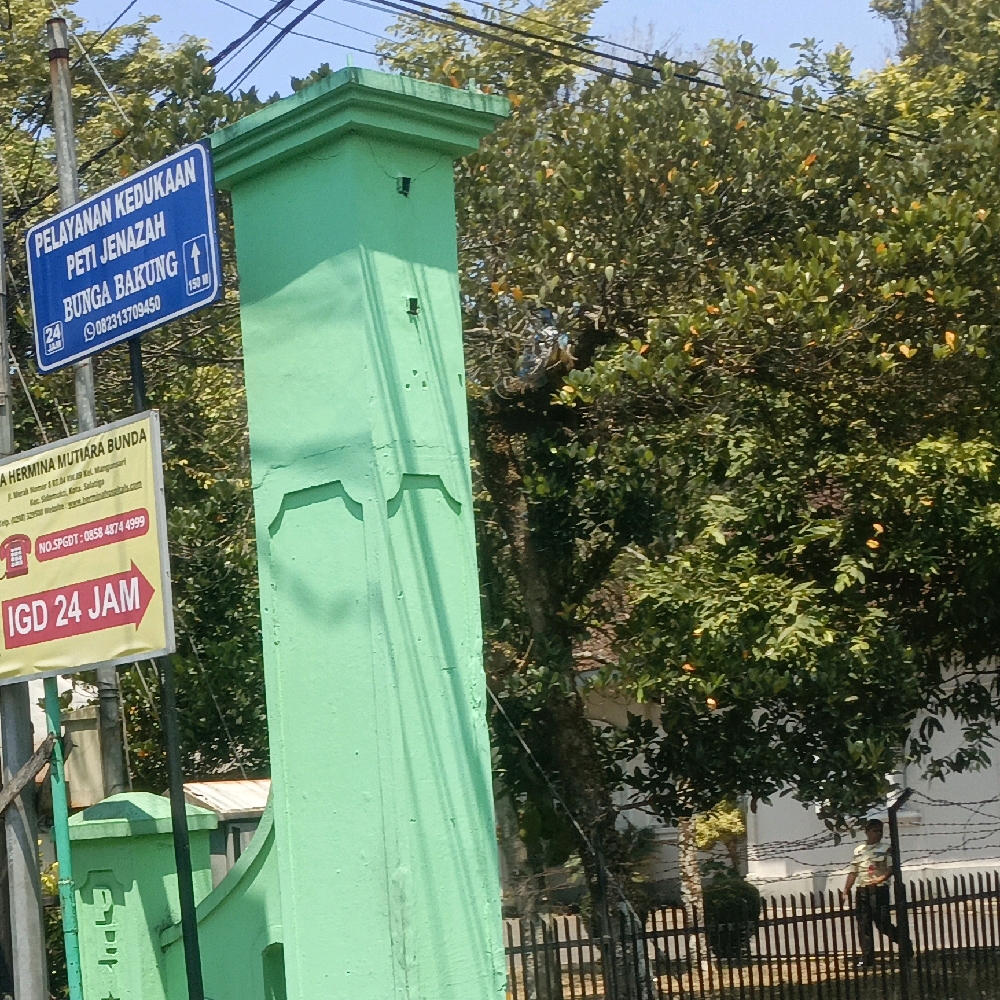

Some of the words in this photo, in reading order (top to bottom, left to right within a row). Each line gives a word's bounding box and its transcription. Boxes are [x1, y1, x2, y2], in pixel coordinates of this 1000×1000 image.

[34, 197, 112, 258] PELAYANAN
[115, 157, 196, 219] KEDUKAAN
[66, 243, 98, 280] PETI
[100, 211, 166, 266] JENAZAH
[63, 280, 112, 322] BUNGA
[114, 251, 178, 298] BAKUNG
[95, 295, 161, 335] 082313709450
[45, 323, 61, 343] 24
[8, 457, 55, 484] HERMINA
[57, 442, 105, 469] MUTIARA
[107, 427, 147, 453] BUNDA
[104, 521, 124, 535] 4874
[125, 515, 145, 530] 4999
[7, 600, 48, 637] IGD
[55, 590, 82, 627] 24
[88, 576, 140, 620] JAM
